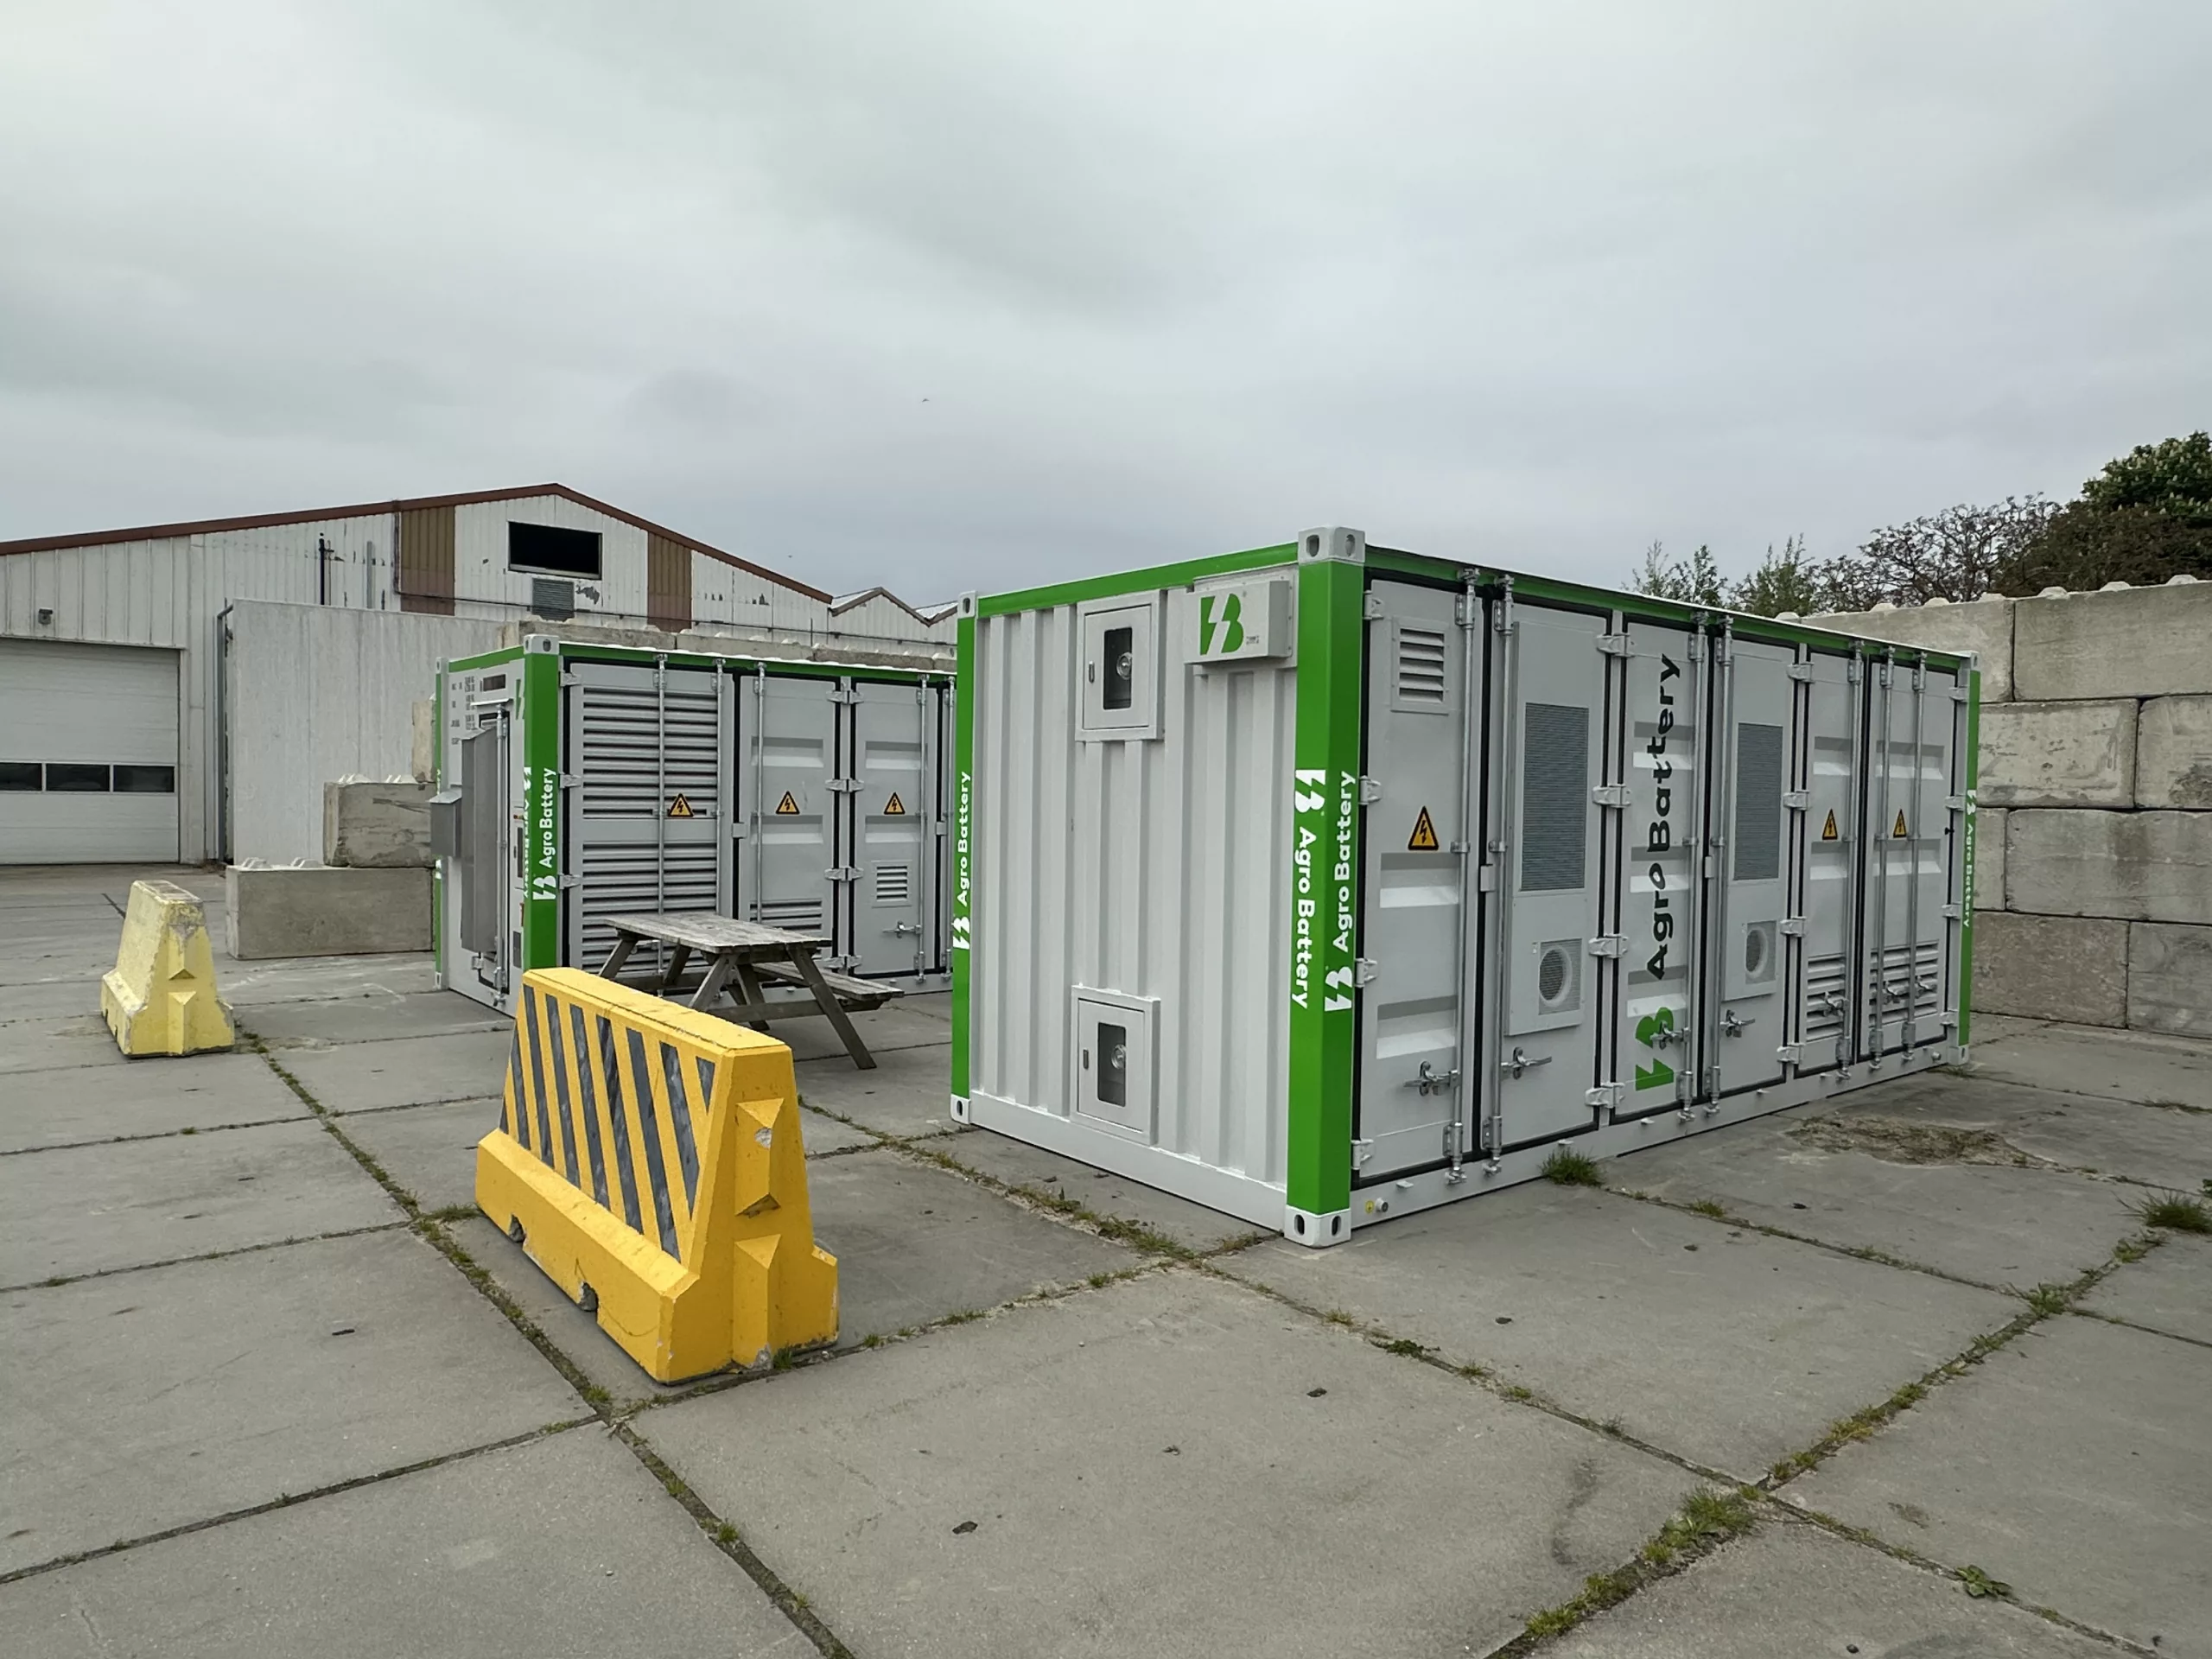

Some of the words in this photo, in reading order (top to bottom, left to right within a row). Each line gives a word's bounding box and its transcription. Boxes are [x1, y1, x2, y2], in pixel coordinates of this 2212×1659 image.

[1646, 653, 1681, 853] Battery
[539, 767, 556, 829] Battery
[957, 772, 971, 853] Battery
[1334, 771, 1356, 880] Battery
[539, 831, 556, 868] Agro
[957, 856, 969, 907] Agro
[1295, 826, 1317, 894] Agro
[1292, 899, 1315, 1009] Battery
[1332, 886, 1352, 952] Agro
[1646, 862, 1674, 980] Agro
